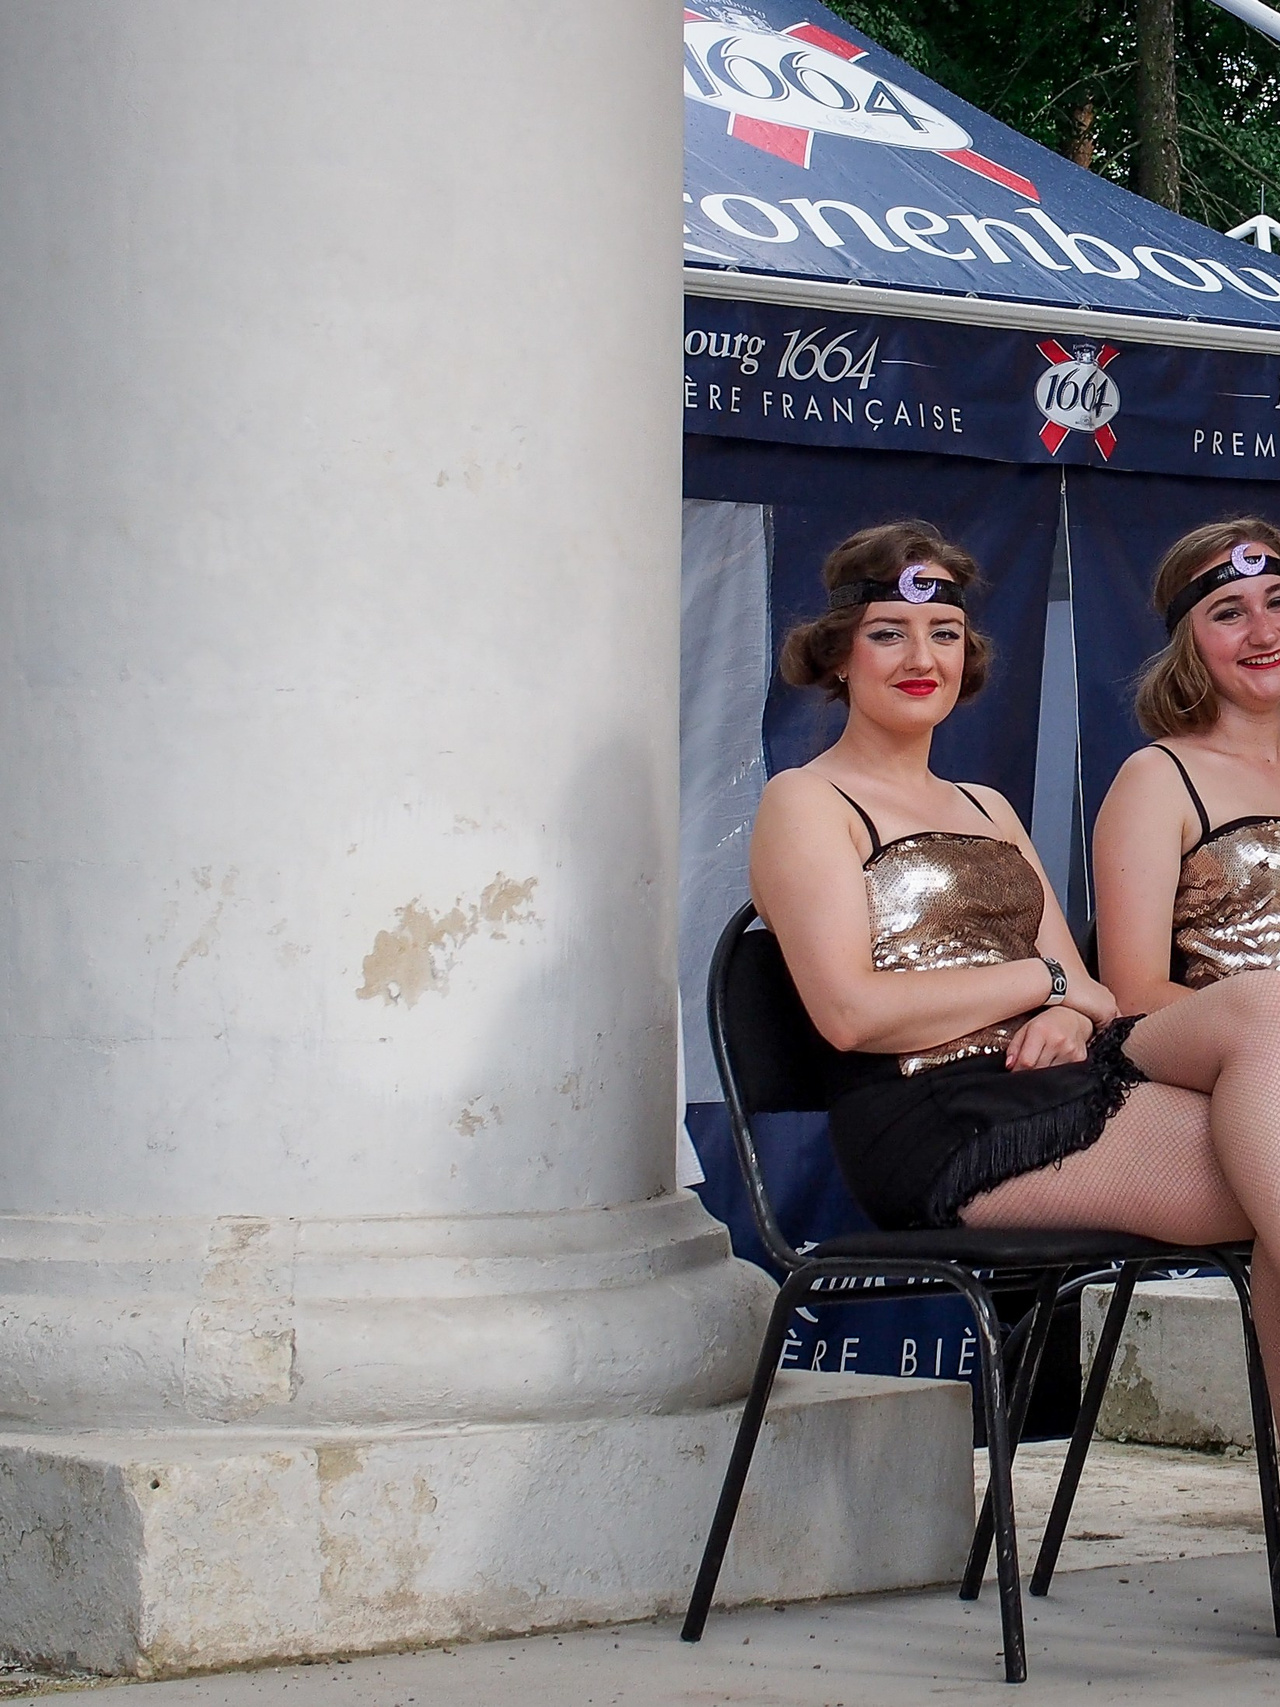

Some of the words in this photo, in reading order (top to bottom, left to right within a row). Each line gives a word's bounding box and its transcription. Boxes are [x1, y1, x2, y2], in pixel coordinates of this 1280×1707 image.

[684, 35, 943, 135] 1664
[684, 328, 766, 375] ourg
[777, 326, 879, 391] 1664
[683, 374, 742, 413] ÈRE
[762, 390, 964, 433] FRANÇAISE
[1044, 366, 1113, 419] 1664
[776, 1327, 861, 1375] ÈRE
[900, 1326, 977, 1377] BIÈ
